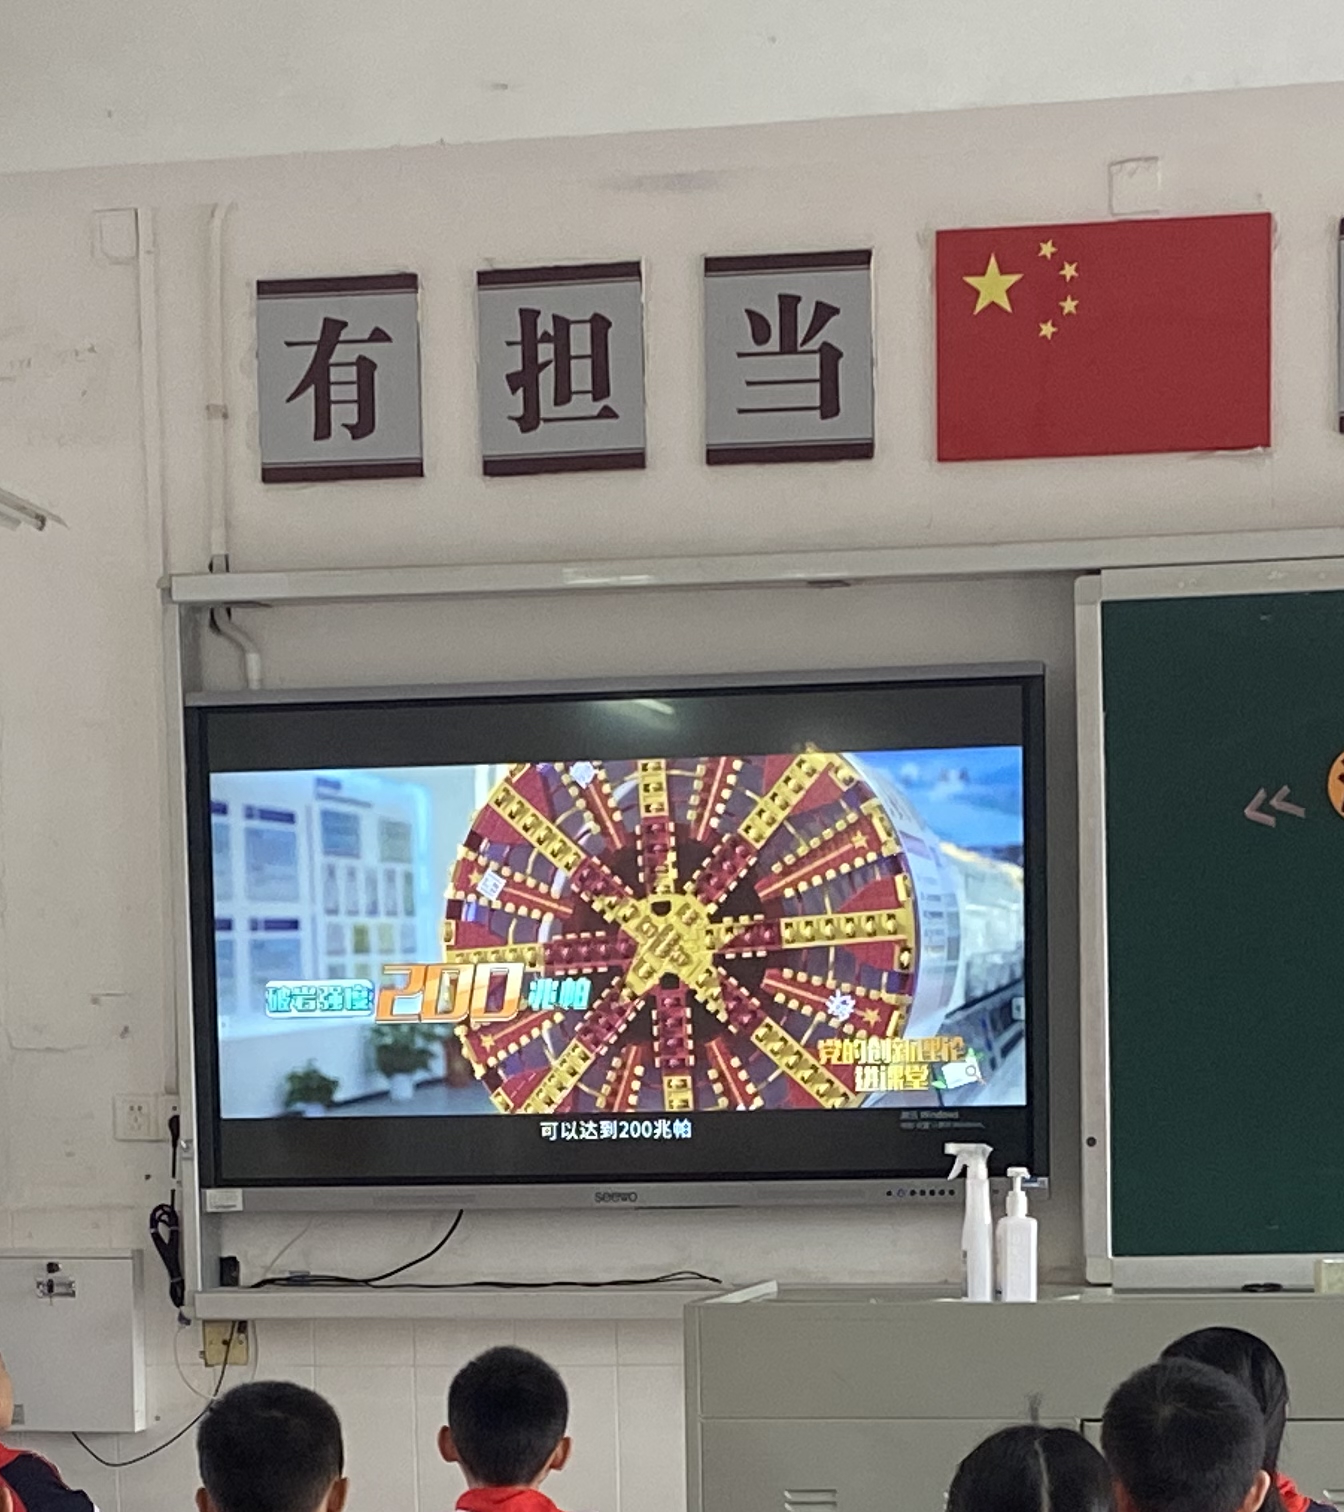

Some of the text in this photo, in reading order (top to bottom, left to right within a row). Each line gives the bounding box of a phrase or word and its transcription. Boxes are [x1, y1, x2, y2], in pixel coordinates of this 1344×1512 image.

[284, 293, 844, 441] 有担当
[540, 1118, 692, 1141] 可以达到200兆帕
